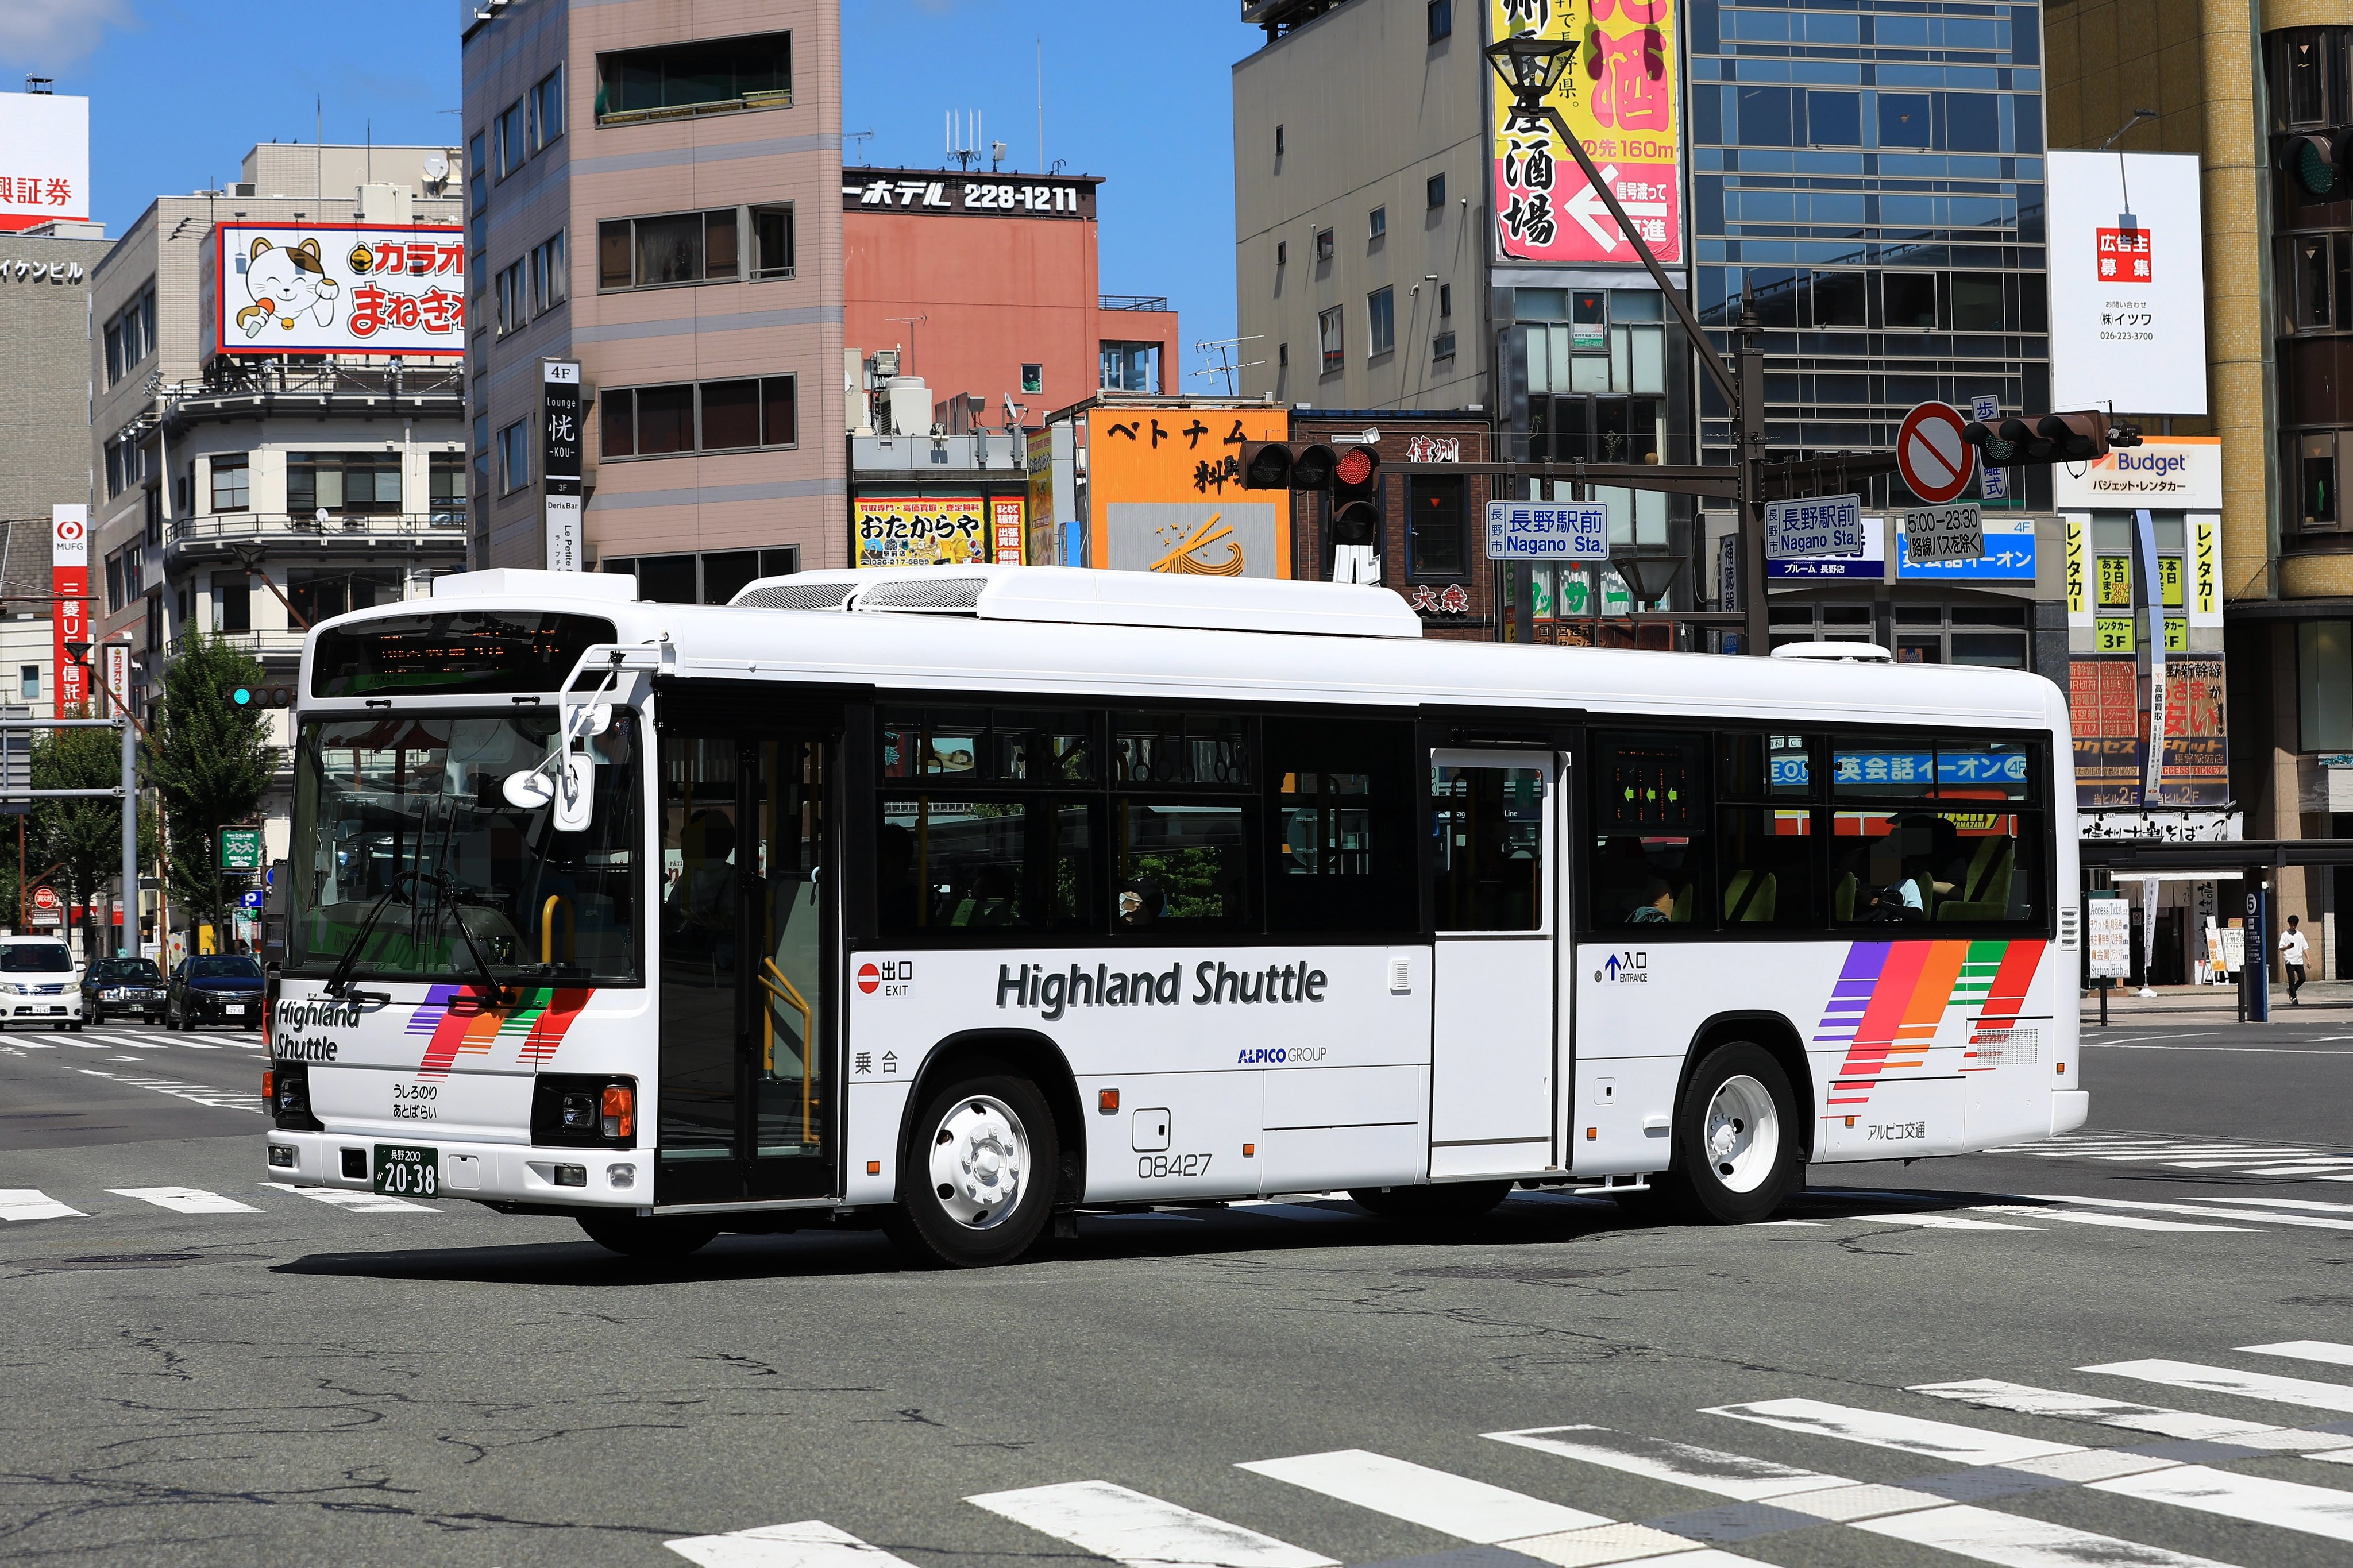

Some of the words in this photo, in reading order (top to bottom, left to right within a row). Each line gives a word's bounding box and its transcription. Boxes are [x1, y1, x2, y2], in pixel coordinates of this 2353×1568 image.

[965, 183, 1077, 212] 228-1211
[1617, 182, 1666, 201] 信号渡って
[2100, 234, 2149, 253] 広告主
[2100, 258, 2150, 277] 募集
[2105, 300, 2147, 309] お問い合わせ
[2100, 331, 2153, 341] 026-223-3700
[551, 366, 571, 379] 4F
[547, 397, 576, 409] Lounge
[548, 414, 575, 442] 恍
[1108, 419, 1247, 449] ベトナム
[549, 447, 576, 458] -KOU-
[1406, 435, 1459, 462] 信州
[2118, 453, 2185, 476] Budget
[558, 484, 568, 492] 3F
[2093, 480, 2186, 492] バジェット・レンタカー
[548, 501, 578, 509] Deri&Bar
[861, 514, 980, 539] おたからや
[1509, 509, 1602, 534] 長野駅前
[1783, 503, 1855, 532] 長野駅前
[1907, 508, 1978, 534] 5:00-23:30
[2013, 522, 2030, 532] 4F
[564, 525, 572, 536] Le
[998, 527, 1019, 537] 出張
[1490, 508, 1503, 553] 長野市
[1768, 509, 1778, 553] 長野市
[56, 543, 84, 551] MUFG
[998, 538, 1019, 547] 買取
[1507, 536, 1566, 555] Nagano
[1575, 536, 1604, 553] Sta.
[1781, 535, 1827, 553] Nagano
[1833, 530, 1857, 546] Sta.
[1909, 531, 1982, 558] (路線バスを除く)
[565, 539, 573, 566] Petite
[1820, 565, 1845, 574] 長野店
[2067, 523, 2082, 612] レンタカー
[2113, 559, 2124, 583] 本日
[2166, 561, 2177, 584] 本日
[2197, 524, 2212, 612] レンタカー
[2102, 559, 2112, 601] あります
[1411, 584, 1469, 613] 大衆
[2098, 621, 2130, 631] レンタカー
[2103, 634, 2126, 648] 3F
[114, 655, 122, 685] カラオケ
[2154, 684, 2163, 721] 高価買取
[1838, 757, 2001, 781] 英会話イーオン
[2162, 766, 2189, 775] CCESS
[2193, 766, 2222, 774] TICKET
[2094, 786, 2138, 804] 当ビル2F
[245, 893, 257, 906] P
[2090, 903, 2109, 915] Access
[2110, 902, 2122, 915] Ticket
[2248, 897, 2254, 910] 5
[1623, 951, 1647, 969] 入口
[2091, 964, 2109, 976] Station
[2111, 963, 2123, 976] Hub
[882, 960, 912, 980] 出口
[1619, 972, 1648, 983] ENTRANCE
[885, 984, 908, 997] EXIT
[996, 961, 1180, 1021] Highland
[1191, 960, 1328, 1005] Shuttle
[277, 1001, 362, 1033] Highland
[276, 1033, 338, 1062] Shuttle
[1238, 1048, 1286, 1064] ALPICO
[1287, 1047, 1327, 1063] GROUP
[855, 1049, 898, 1075] 乗合
[393, 1084, 438, 1100] うしろのり
[393, 1104, 437, 1120] あとばらい
[1867, 1121, 1926, 1141] アルピコ交通
[1138, 1153, 1213, 1179] 08427
[376, 1171, 384, 1181] か
[385, 1162, 435, 1194] 20-38
